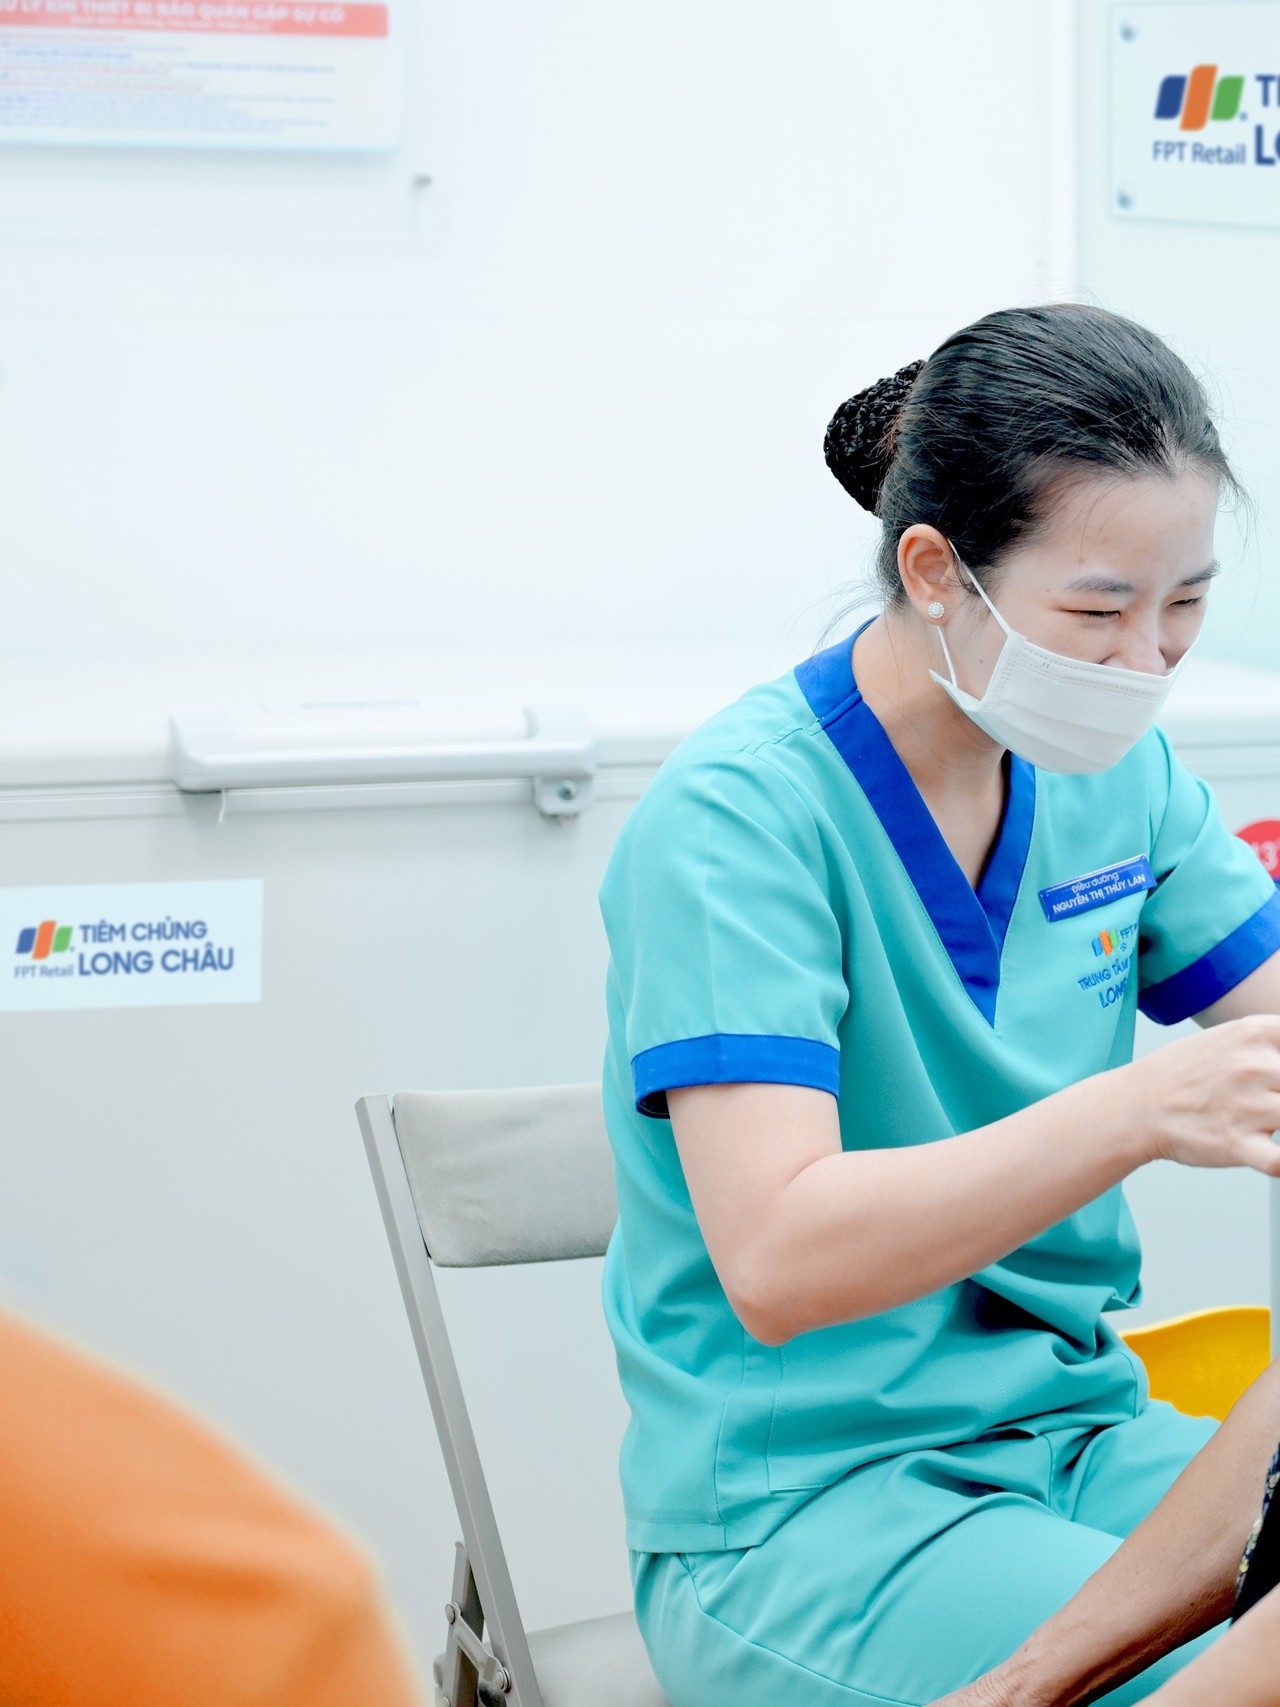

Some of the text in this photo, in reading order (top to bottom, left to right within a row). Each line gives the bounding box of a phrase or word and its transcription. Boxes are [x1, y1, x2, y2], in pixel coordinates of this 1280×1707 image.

[1153, 141, 1246, 164] FPT Retail
[1127, 874, 1146, 887] LAN
[79, 916, 207, 943] TIÊM CHỦNG
[1120, 925, 1133, 939] FPT
[79, 942, 234, 976] LONG CHÂU
[14, 965, 73, 979] FPT Retail
[1078, 969, 1111, 990] TRUNG
